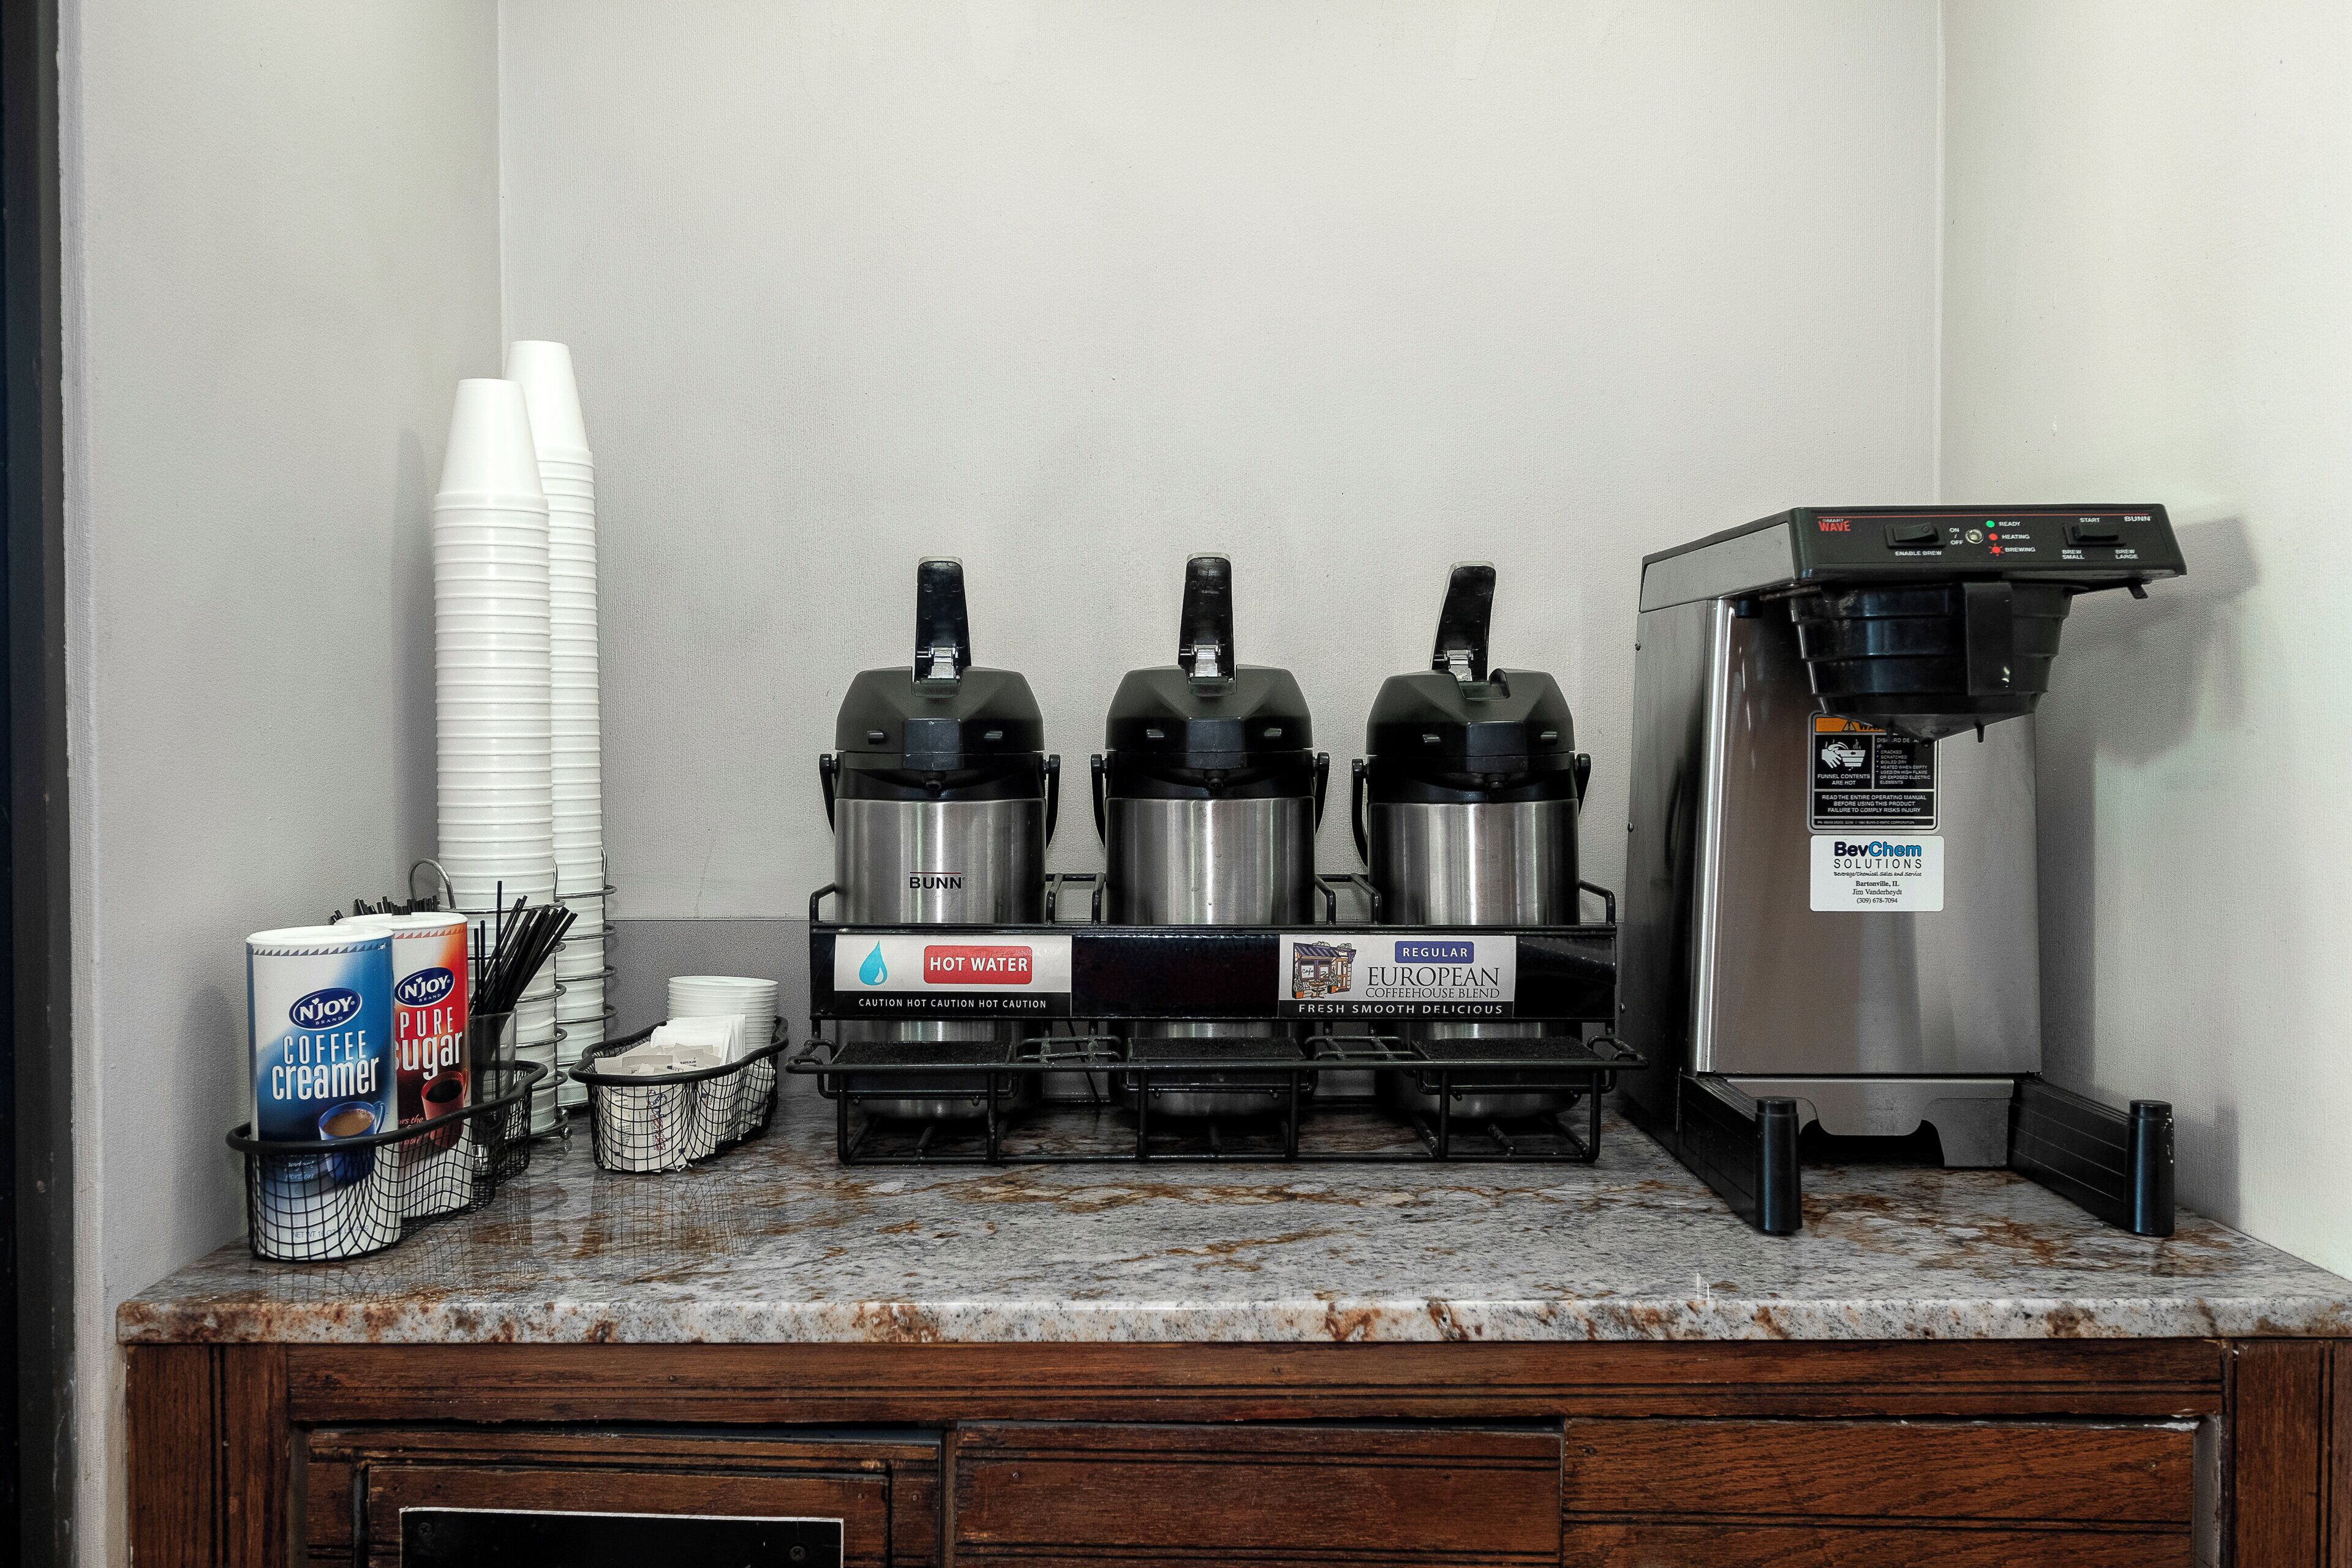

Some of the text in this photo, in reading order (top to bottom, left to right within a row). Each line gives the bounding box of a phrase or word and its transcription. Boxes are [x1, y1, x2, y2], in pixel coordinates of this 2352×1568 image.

[1818, 521, 1851, 532] WAVE
[1834, 841, 1922, 857] BevChem
[1834, 859, 1922, 869] SOLUTIONS
[910, 876, 962, 889] BUNN
[1403, 948, 1468, 957] REGULAR
[930, 957, 1028, 971] HOT WATER
[1368, 967, 1499, 986] EUROPEAN
[419, 993, 442, 1002] BRAND
[1365, 987, 1500, 998] COFFEEHOUSE BLEND
[907, 999, 927, 1008] HOT
[979, 1000, 998, 1008] HOT
[1298, 1004, 1503, 1014] FRESH SMOOTH DELICIOUS
[315, 1016, 343, 1025] BRAND
[399, 1007, 453, 1038] PURE
[283, 1030, 367, 1065] COFFEE
[272, 1057, 380, 1101] creamer
[410, 1114, 424, 1123] the
